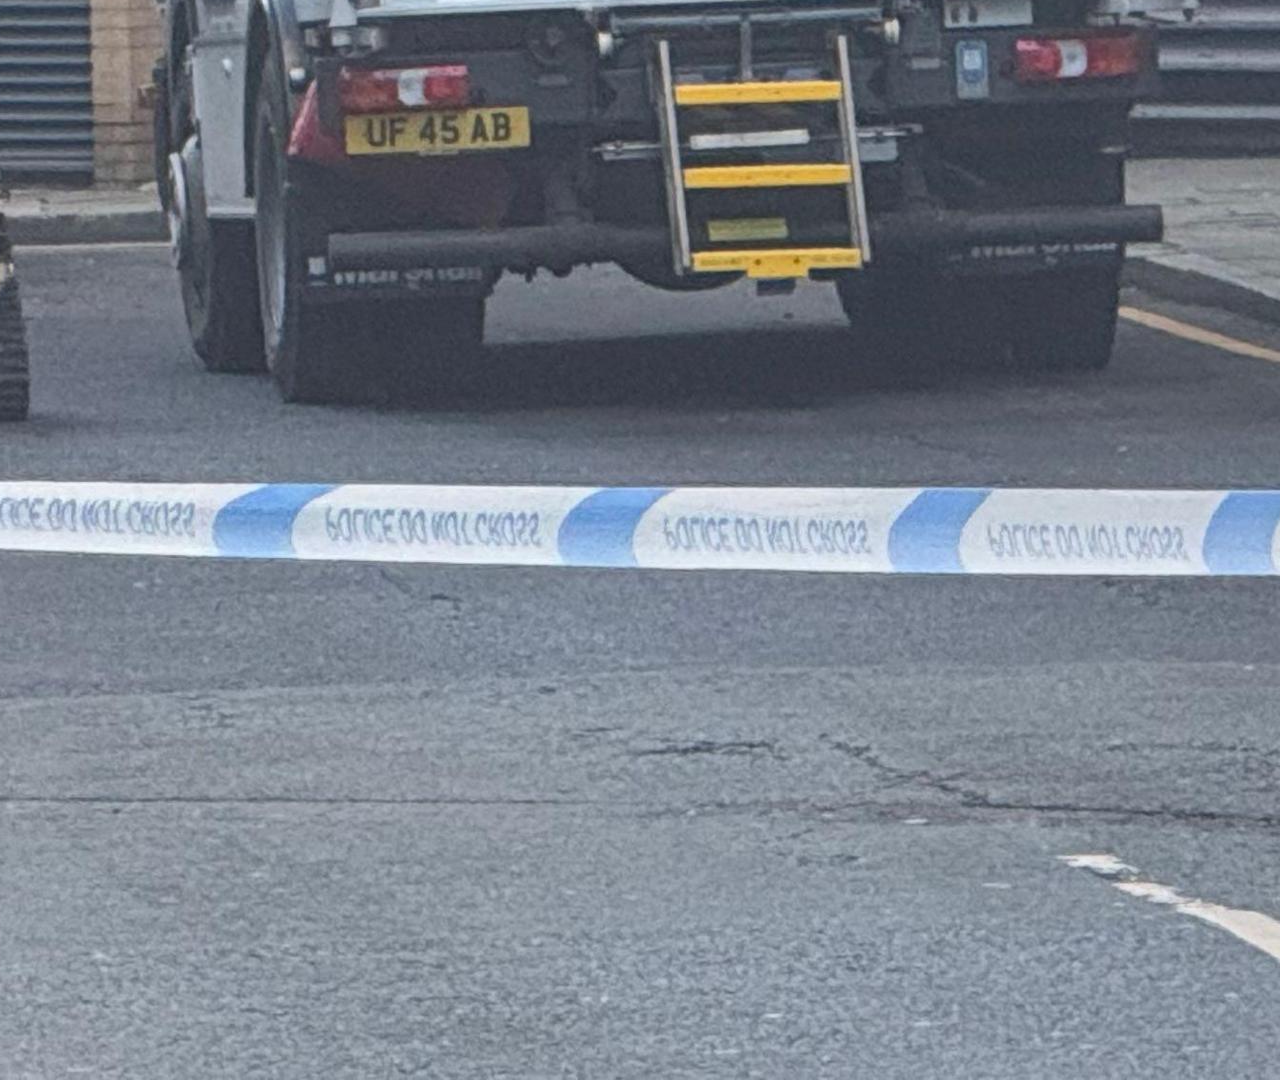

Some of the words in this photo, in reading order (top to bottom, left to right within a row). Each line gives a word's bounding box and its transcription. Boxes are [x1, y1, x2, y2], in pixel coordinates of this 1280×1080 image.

[367, 117, 407, 147] UF
[419, 114, 460, 145] 45
[470, 112, 512, 144] AB
